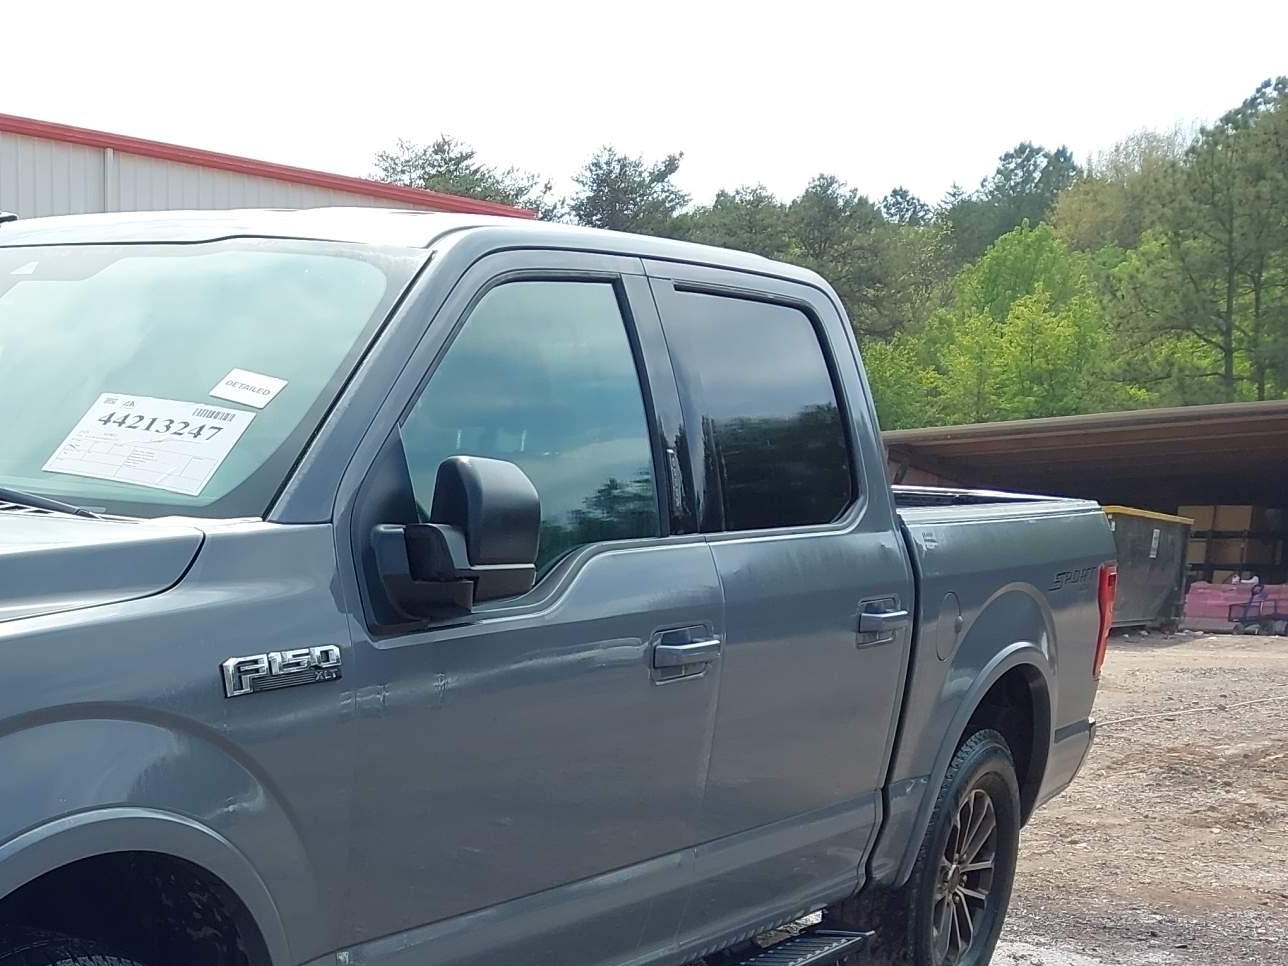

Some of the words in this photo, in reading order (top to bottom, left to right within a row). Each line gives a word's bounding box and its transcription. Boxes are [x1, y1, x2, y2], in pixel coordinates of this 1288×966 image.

[225, 380, 271, 396] DETAILED
[98, 411, 224, 441] 44213247
[314, 669, 338, 681] XLT
